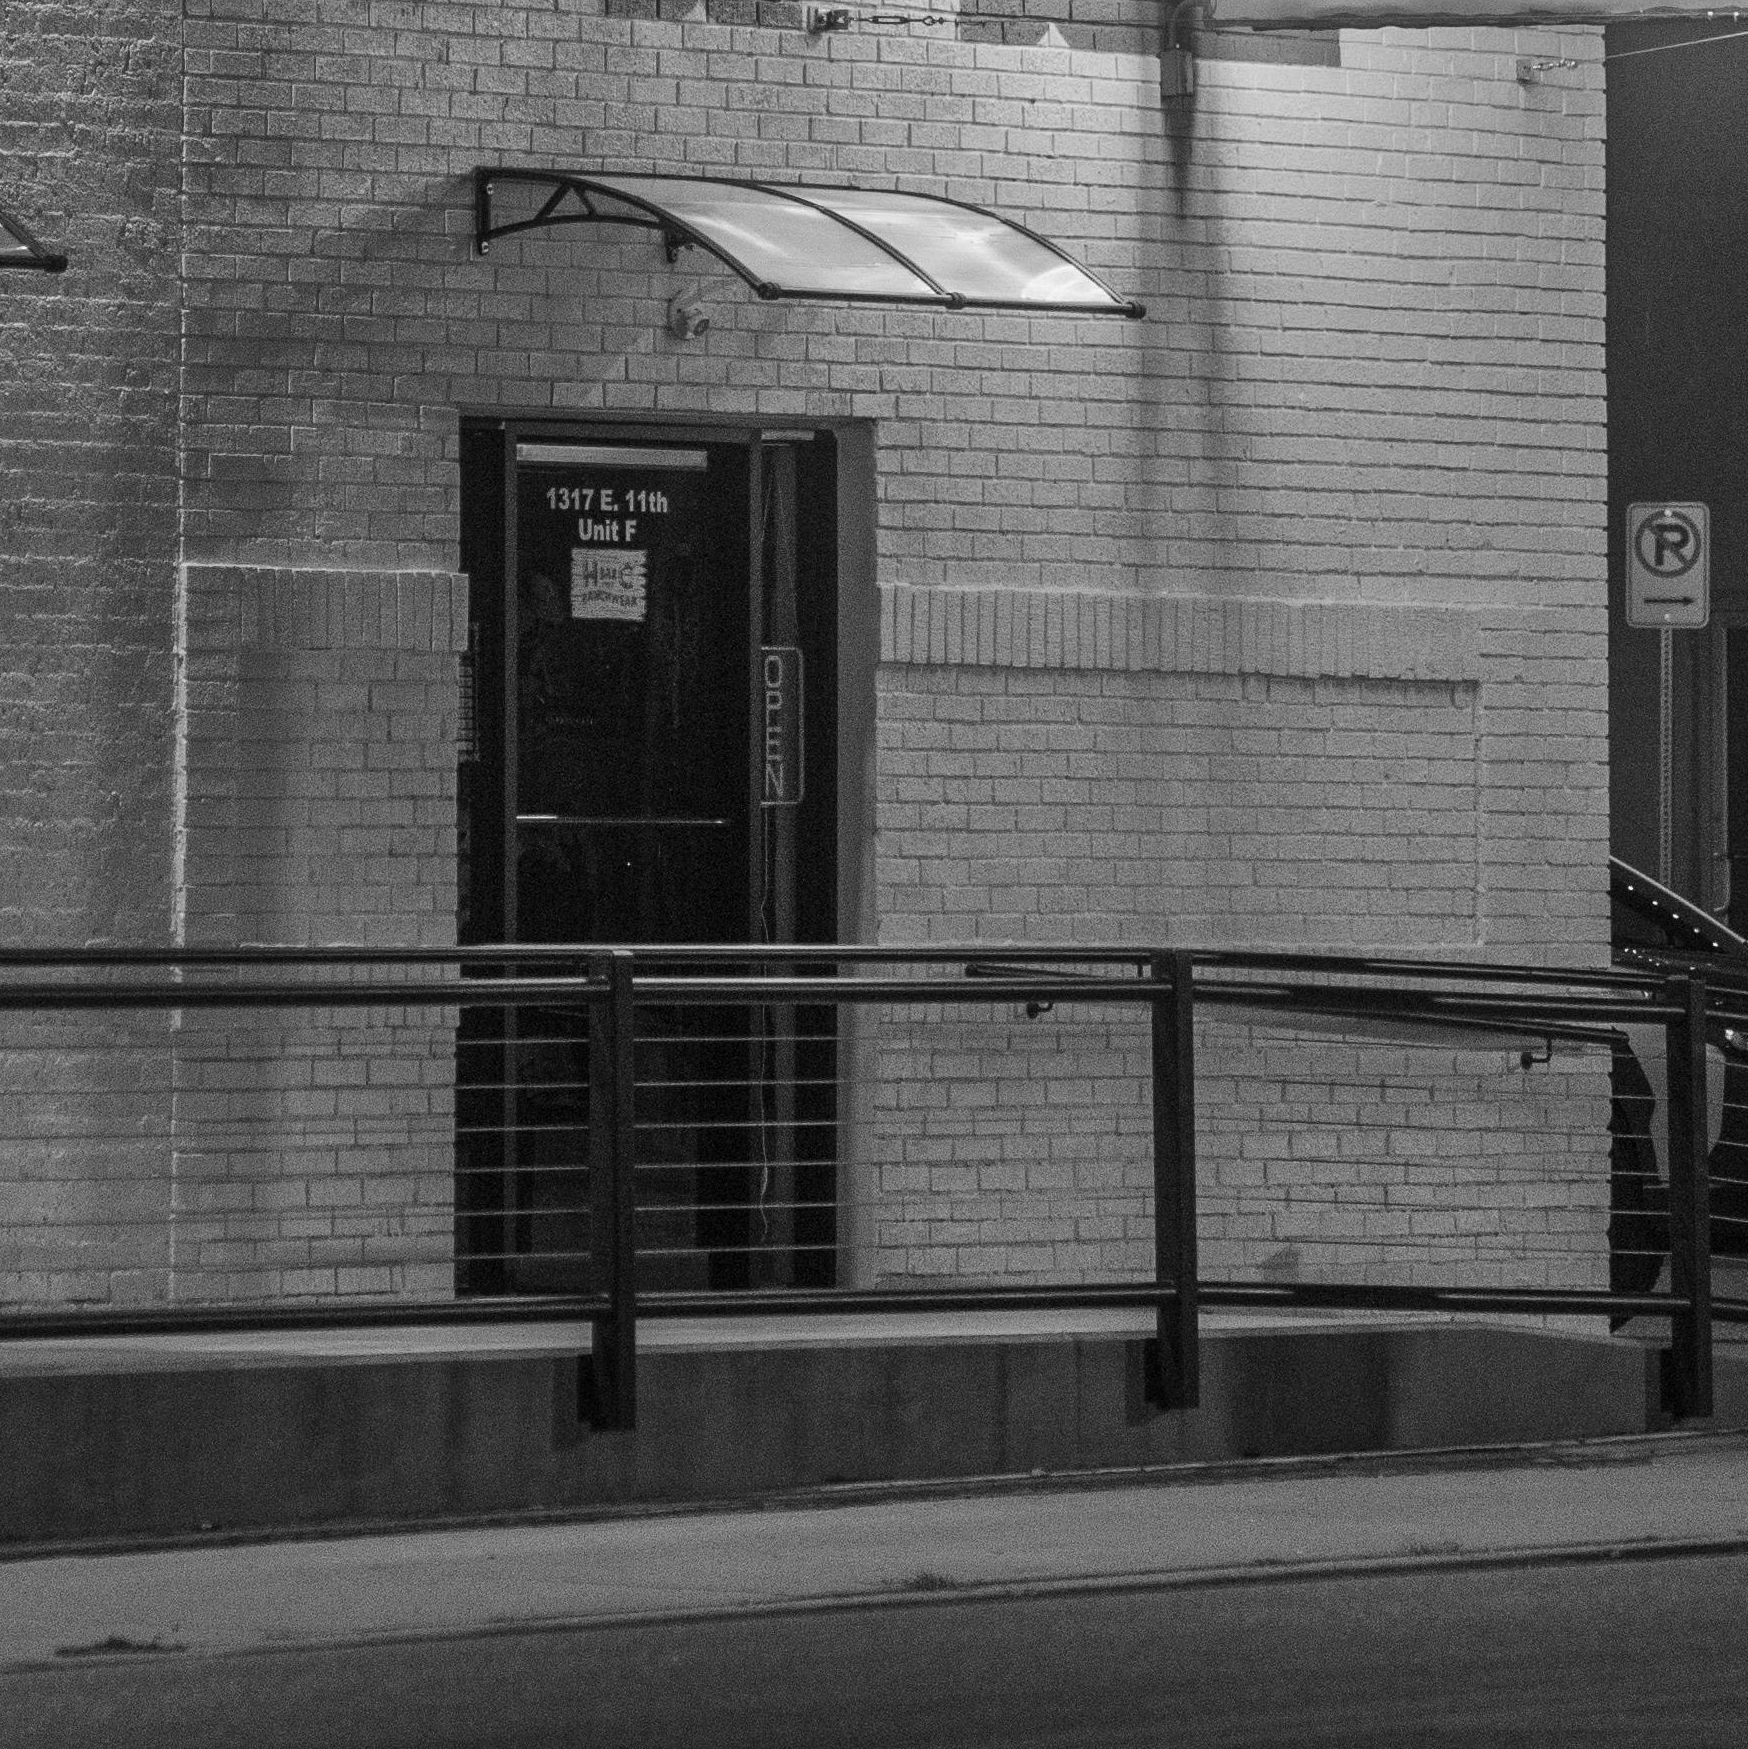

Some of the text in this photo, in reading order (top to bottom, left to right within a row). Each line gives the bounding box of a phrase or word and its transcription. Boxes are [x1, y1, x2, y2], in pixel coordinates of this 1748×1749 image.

[546, 488, 668, 514] 1317 E. 11th
[578, 518, 637, 542] Unit F
[764, 654, 783, 797] OPEN
